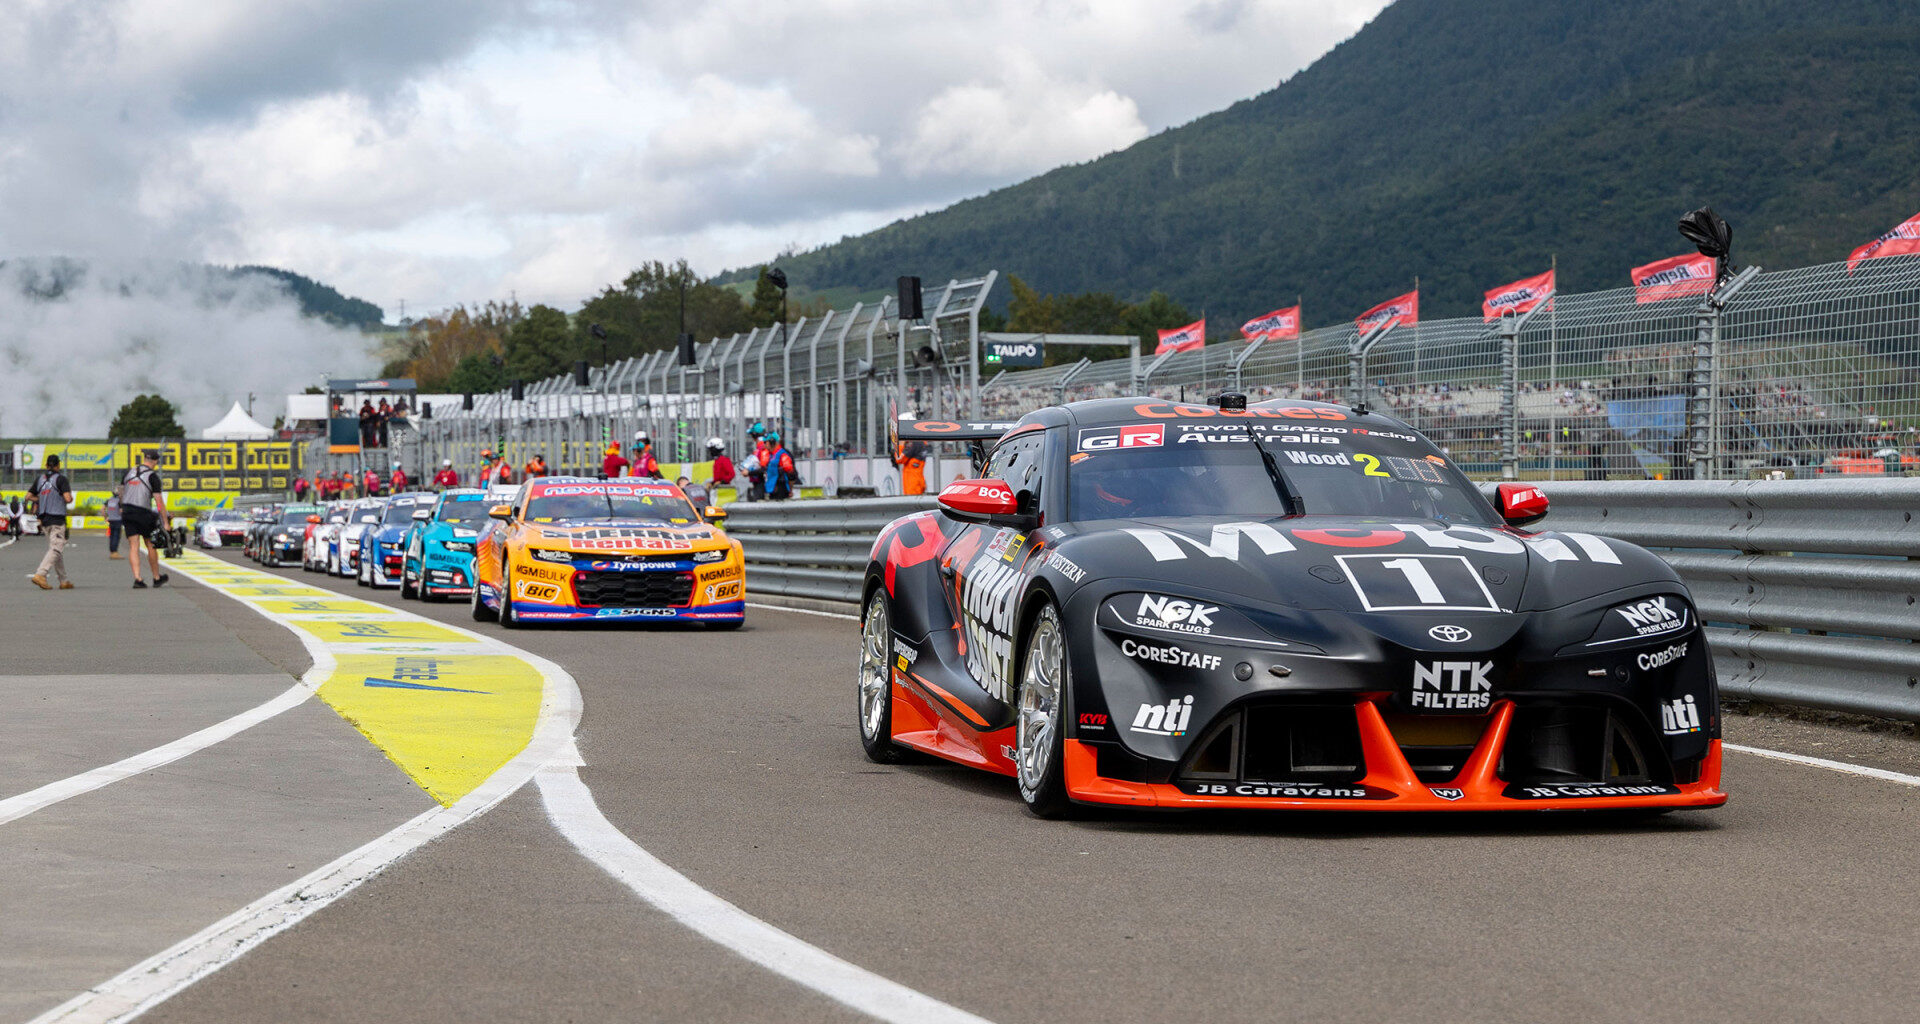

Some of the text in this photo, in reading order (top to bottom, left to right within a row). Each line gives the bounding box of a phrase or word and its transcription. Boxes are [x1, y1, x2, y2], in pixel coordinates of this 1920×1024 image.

[993, 343, 1037, 358] TAUPŌ
[1081, 432, 1161, 450] GR
[1177, 433, 1340, 445] Australia
[1272, 424, 1347, 434] GAZOO
[1352, 428, 1417, 443] Racing
[1284, 450, 1391, 478] Wood 2
[641, 496, 653, 506] 4
[978, 486, 1012, 501] BOC
[570, 537, 691, 550] Rentals
[1118, 521, 1622, 566] Mobil
[613, 561, 677, 572] Tyrepower
[1047, 552, 1087, 584] WESTERN
[1382, 558, 1447, 604] 1
[963, 553, 1027, 638] TRUCK
[1137, 593, 1220, 627] NGK
[1616, 596, 1678, 628] NGK
[1136, 616, 1212, 634] SPARK PLUGS
[1637, 618, 1681, 635] SPARK PLUGS
[1413, 660, 1494, 691] NTK
[1411, 691, 1491, 708] FILTERS
[1079, 713, 1108, 725] KYB
[1134, 694, 1195, 732] nti
[1661, 694, 1700, 731] nti
[1196, 784, 1367, 797] JB Caravans
[1523, 784, 1667, 798] JB Caravans
